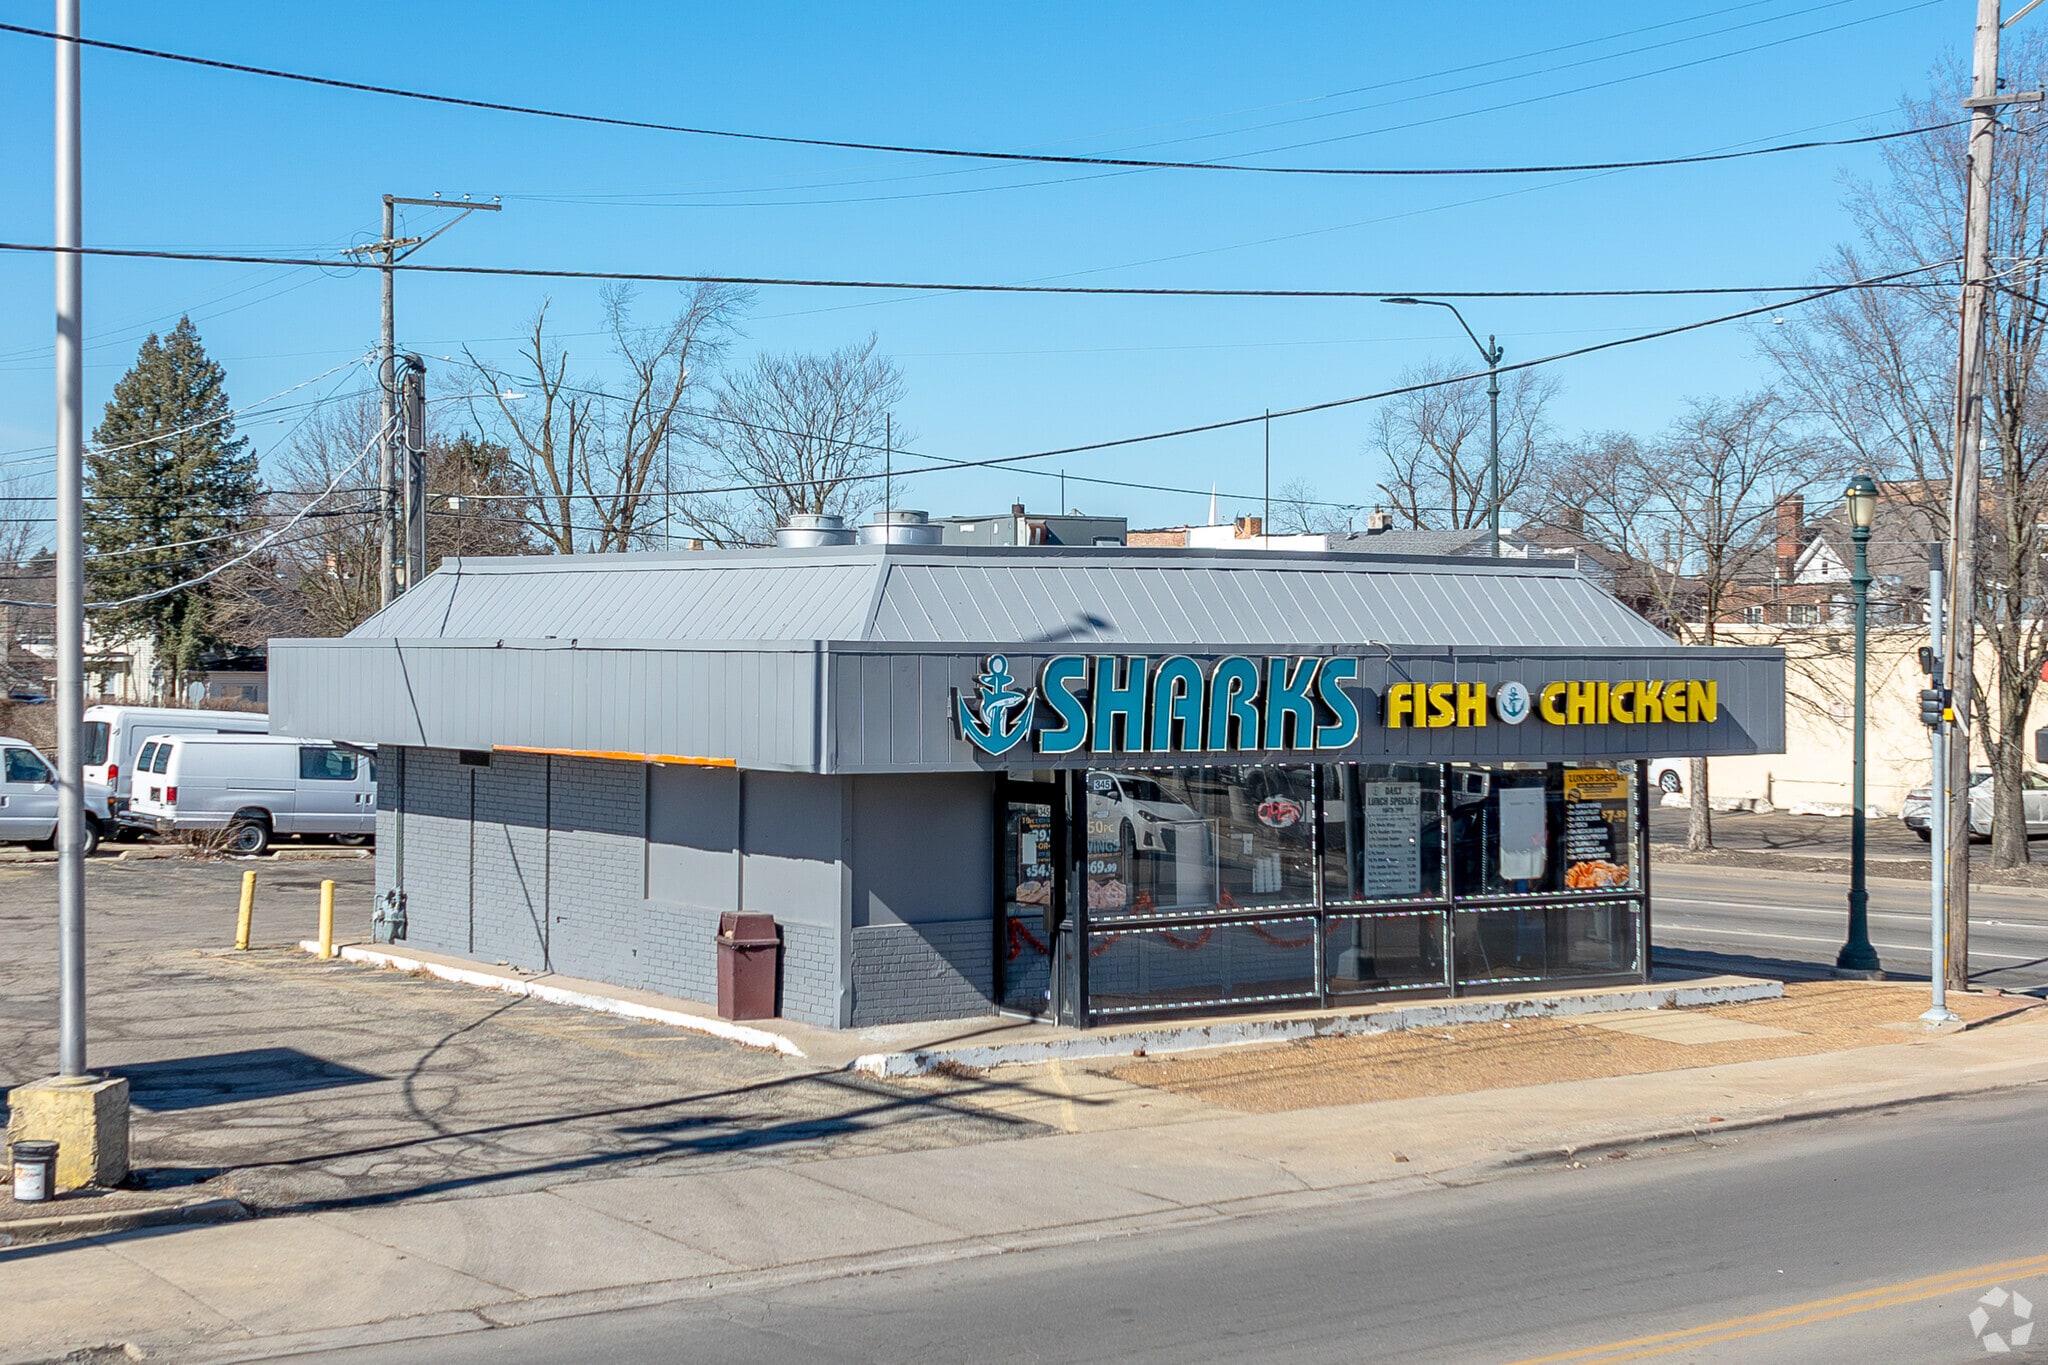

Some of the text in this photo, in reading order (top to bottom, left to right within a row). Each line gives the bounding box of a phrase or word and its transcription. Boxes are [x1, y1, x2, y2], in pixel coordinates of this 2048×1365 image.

[1037, 655, 1360, 755] SHARKS
[1387, 679, 1718, 729] FISH CHICKEN
[1094, 779, 1111, 790] 345
[1568, 773, 1594, 782] LUNCH
[1389, 797, 1419, 806] SPECIALS
[1257, 802, 1299, 821] OPEN
